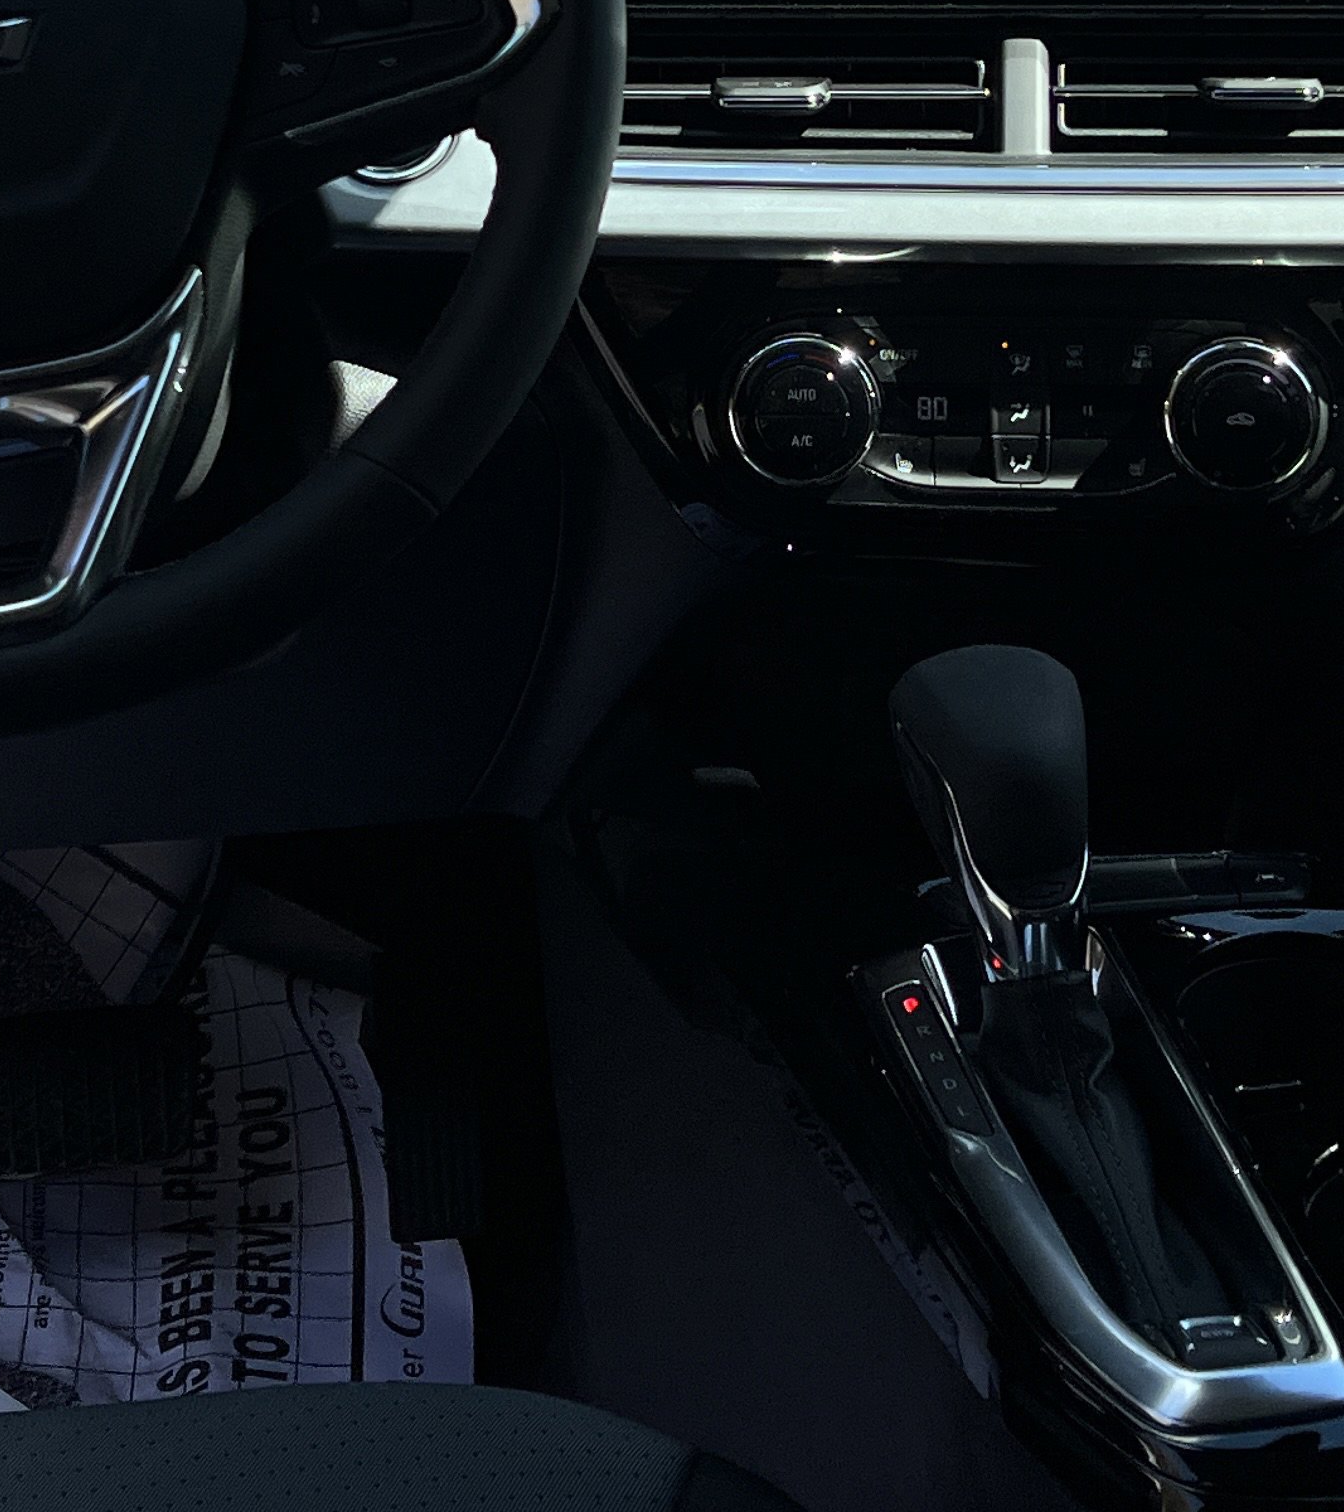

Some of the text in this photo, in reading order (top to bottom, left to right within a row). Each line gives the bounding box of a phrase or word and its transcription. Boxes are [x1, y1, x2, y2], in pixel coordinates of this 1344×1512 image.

[787, 388, 817, 402] AUTO
[790, 435, 814, 448] A/C
[916, 1025, 933, 1037] R
[928, 1050, 945, 1063] N
[942, 1078, 957, 1090] D
[159, 1213, 217, 1238] A
[231, 1086, 294, 1383] TO SERVE YOU
[158, 1246, 216, 1354] BEEN
[33, 1294, 51, 1330] are
[402, 1348, 424, 1378] er
